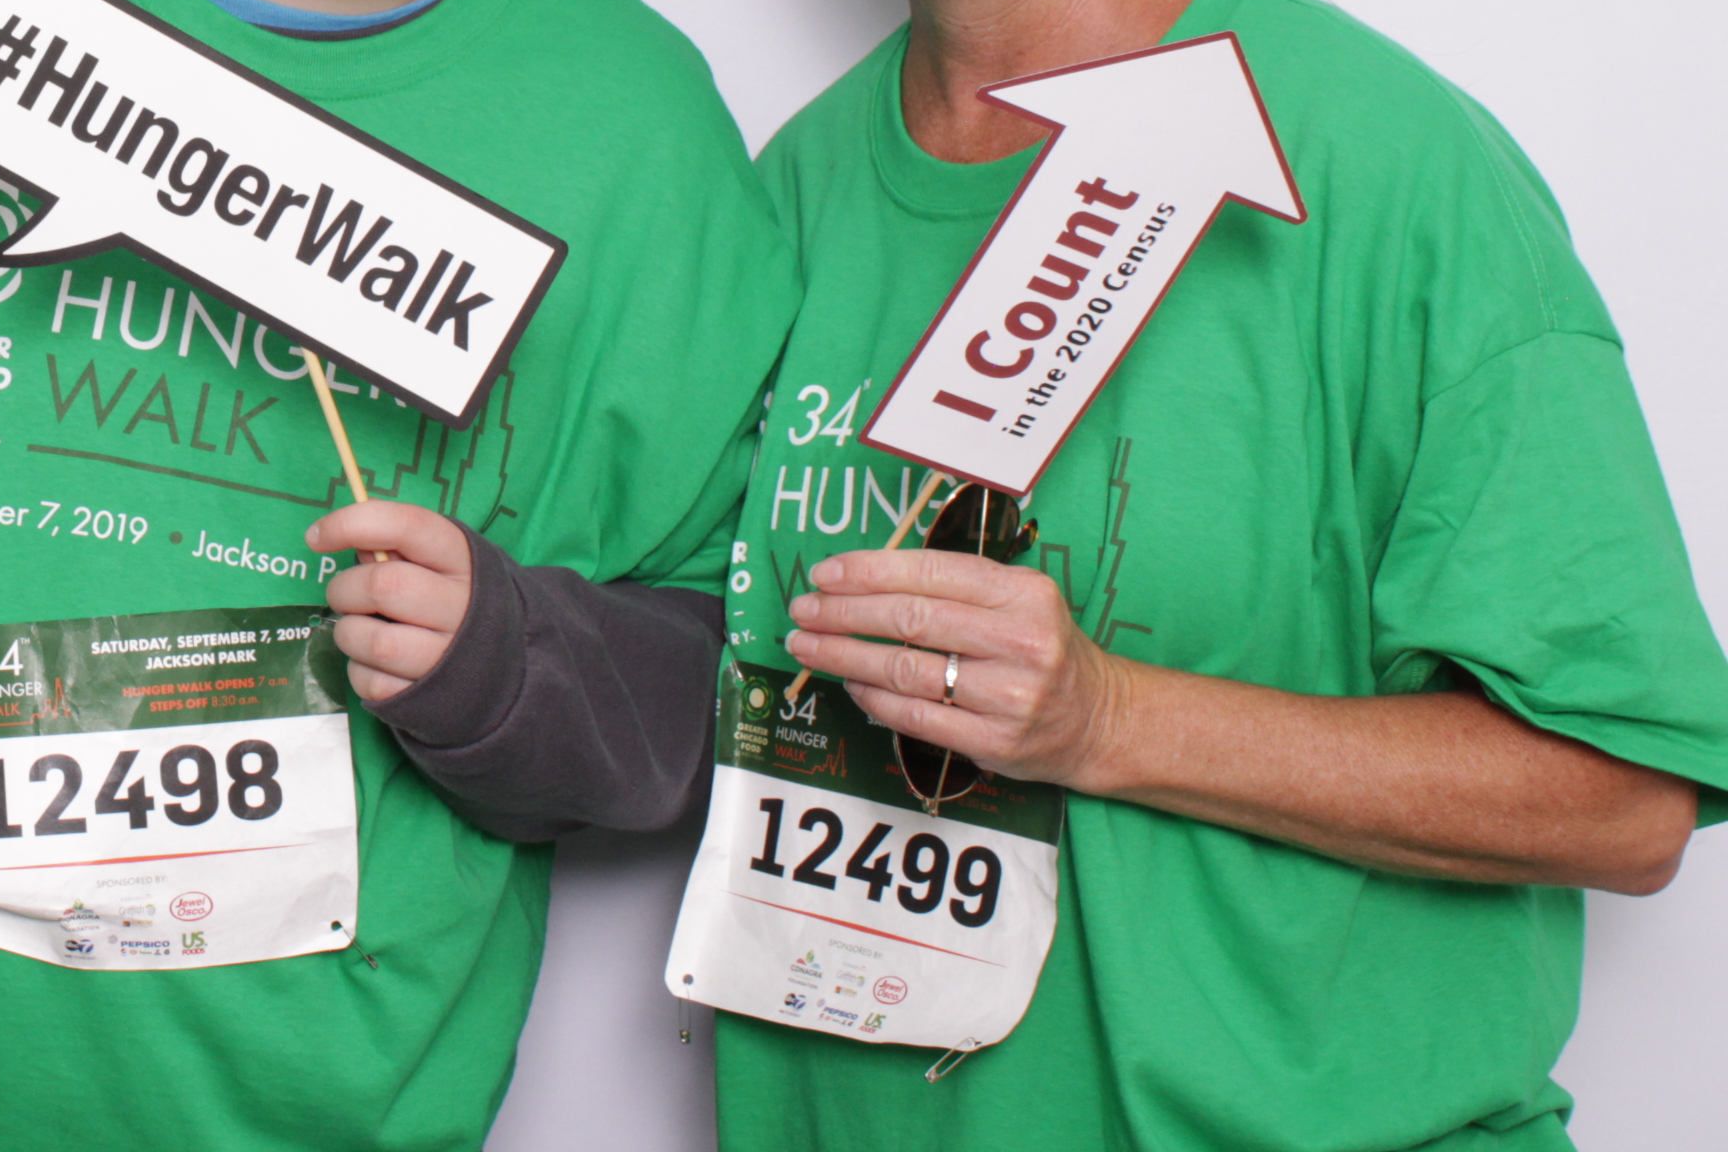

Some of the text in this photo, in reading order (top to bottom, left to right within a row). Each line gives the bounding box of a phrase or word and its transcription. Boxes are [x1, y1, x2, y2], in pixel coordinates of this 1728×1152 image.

[932, 176, 1140, 423] I Count
[1001, 200, 1177, 439] in the 2020 Census
[51, 269, 407, 408] HUNG
[46, 353, 280, 465] WALK
[36, 500, 61, 538] 7,
[71, 505, 149, 546] 2019
[191, 529, 308, 580] Jackson
[91, 626, 311, 655] SATURDAY, SEPTEMBER 7, 2019
[145, 649, 257, 670] JACKSON PARK
[122, 676, 290, 698] HUNGER WALK OPENS 7 a.m.
[149, 694, 260, 712] STEPS OFF 8:30 a.m.
[734, 731, 768, 746] CHICAGO
[737, 722, 769, 736] GREATER
[775, 726, 828, 749] HUNGER
[775, 744, 808, 763] WALK
[750, 798, 1002, 929] 12499
[96, 875, 153, 888] SPONSORED
[175, 897, 206, 908] Jewel
[121, 940, 170, 948] PEPSICO
[790, 964, 823, 979] CONAGRA
[823, 1007, 859, 1020] PEPSICO
